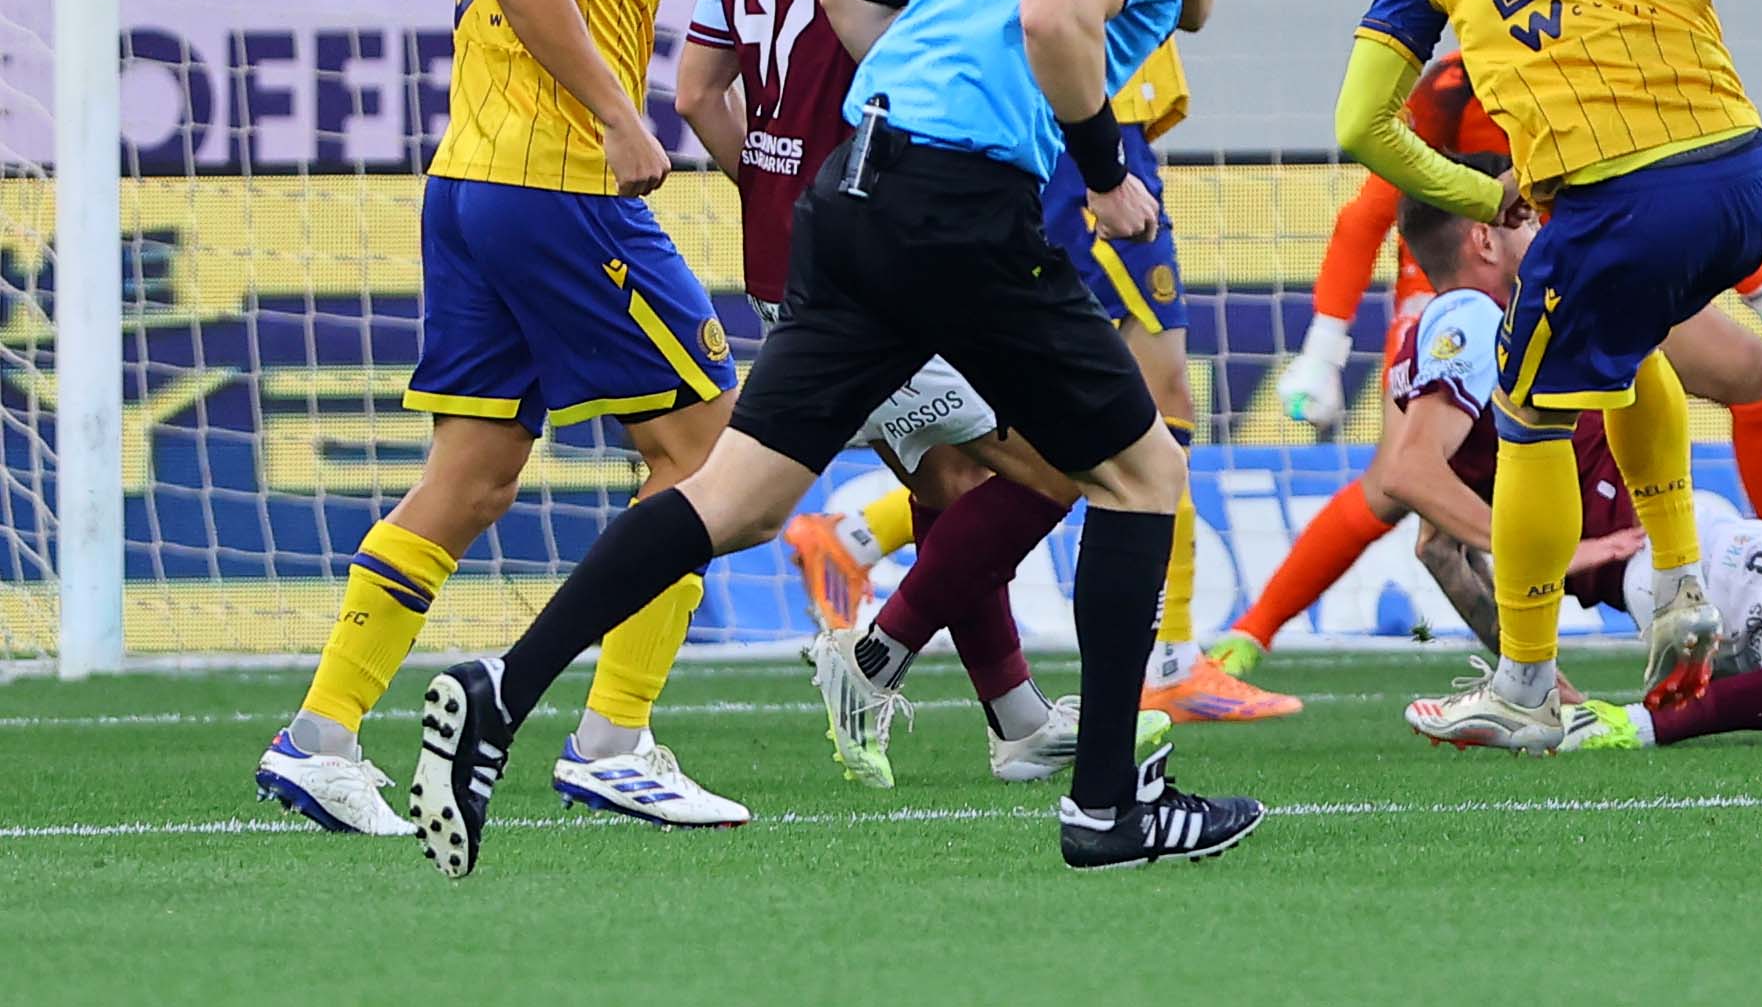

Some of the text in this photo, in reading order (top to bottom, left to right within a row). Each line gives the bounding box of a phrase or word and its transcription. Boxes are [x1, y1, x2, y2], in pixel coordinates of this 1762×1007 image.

[884, 390, 964, 440] ROSSOS
[1633, 478, 1686, 498] AEL FC
[343, 610, 370, 627] FC
